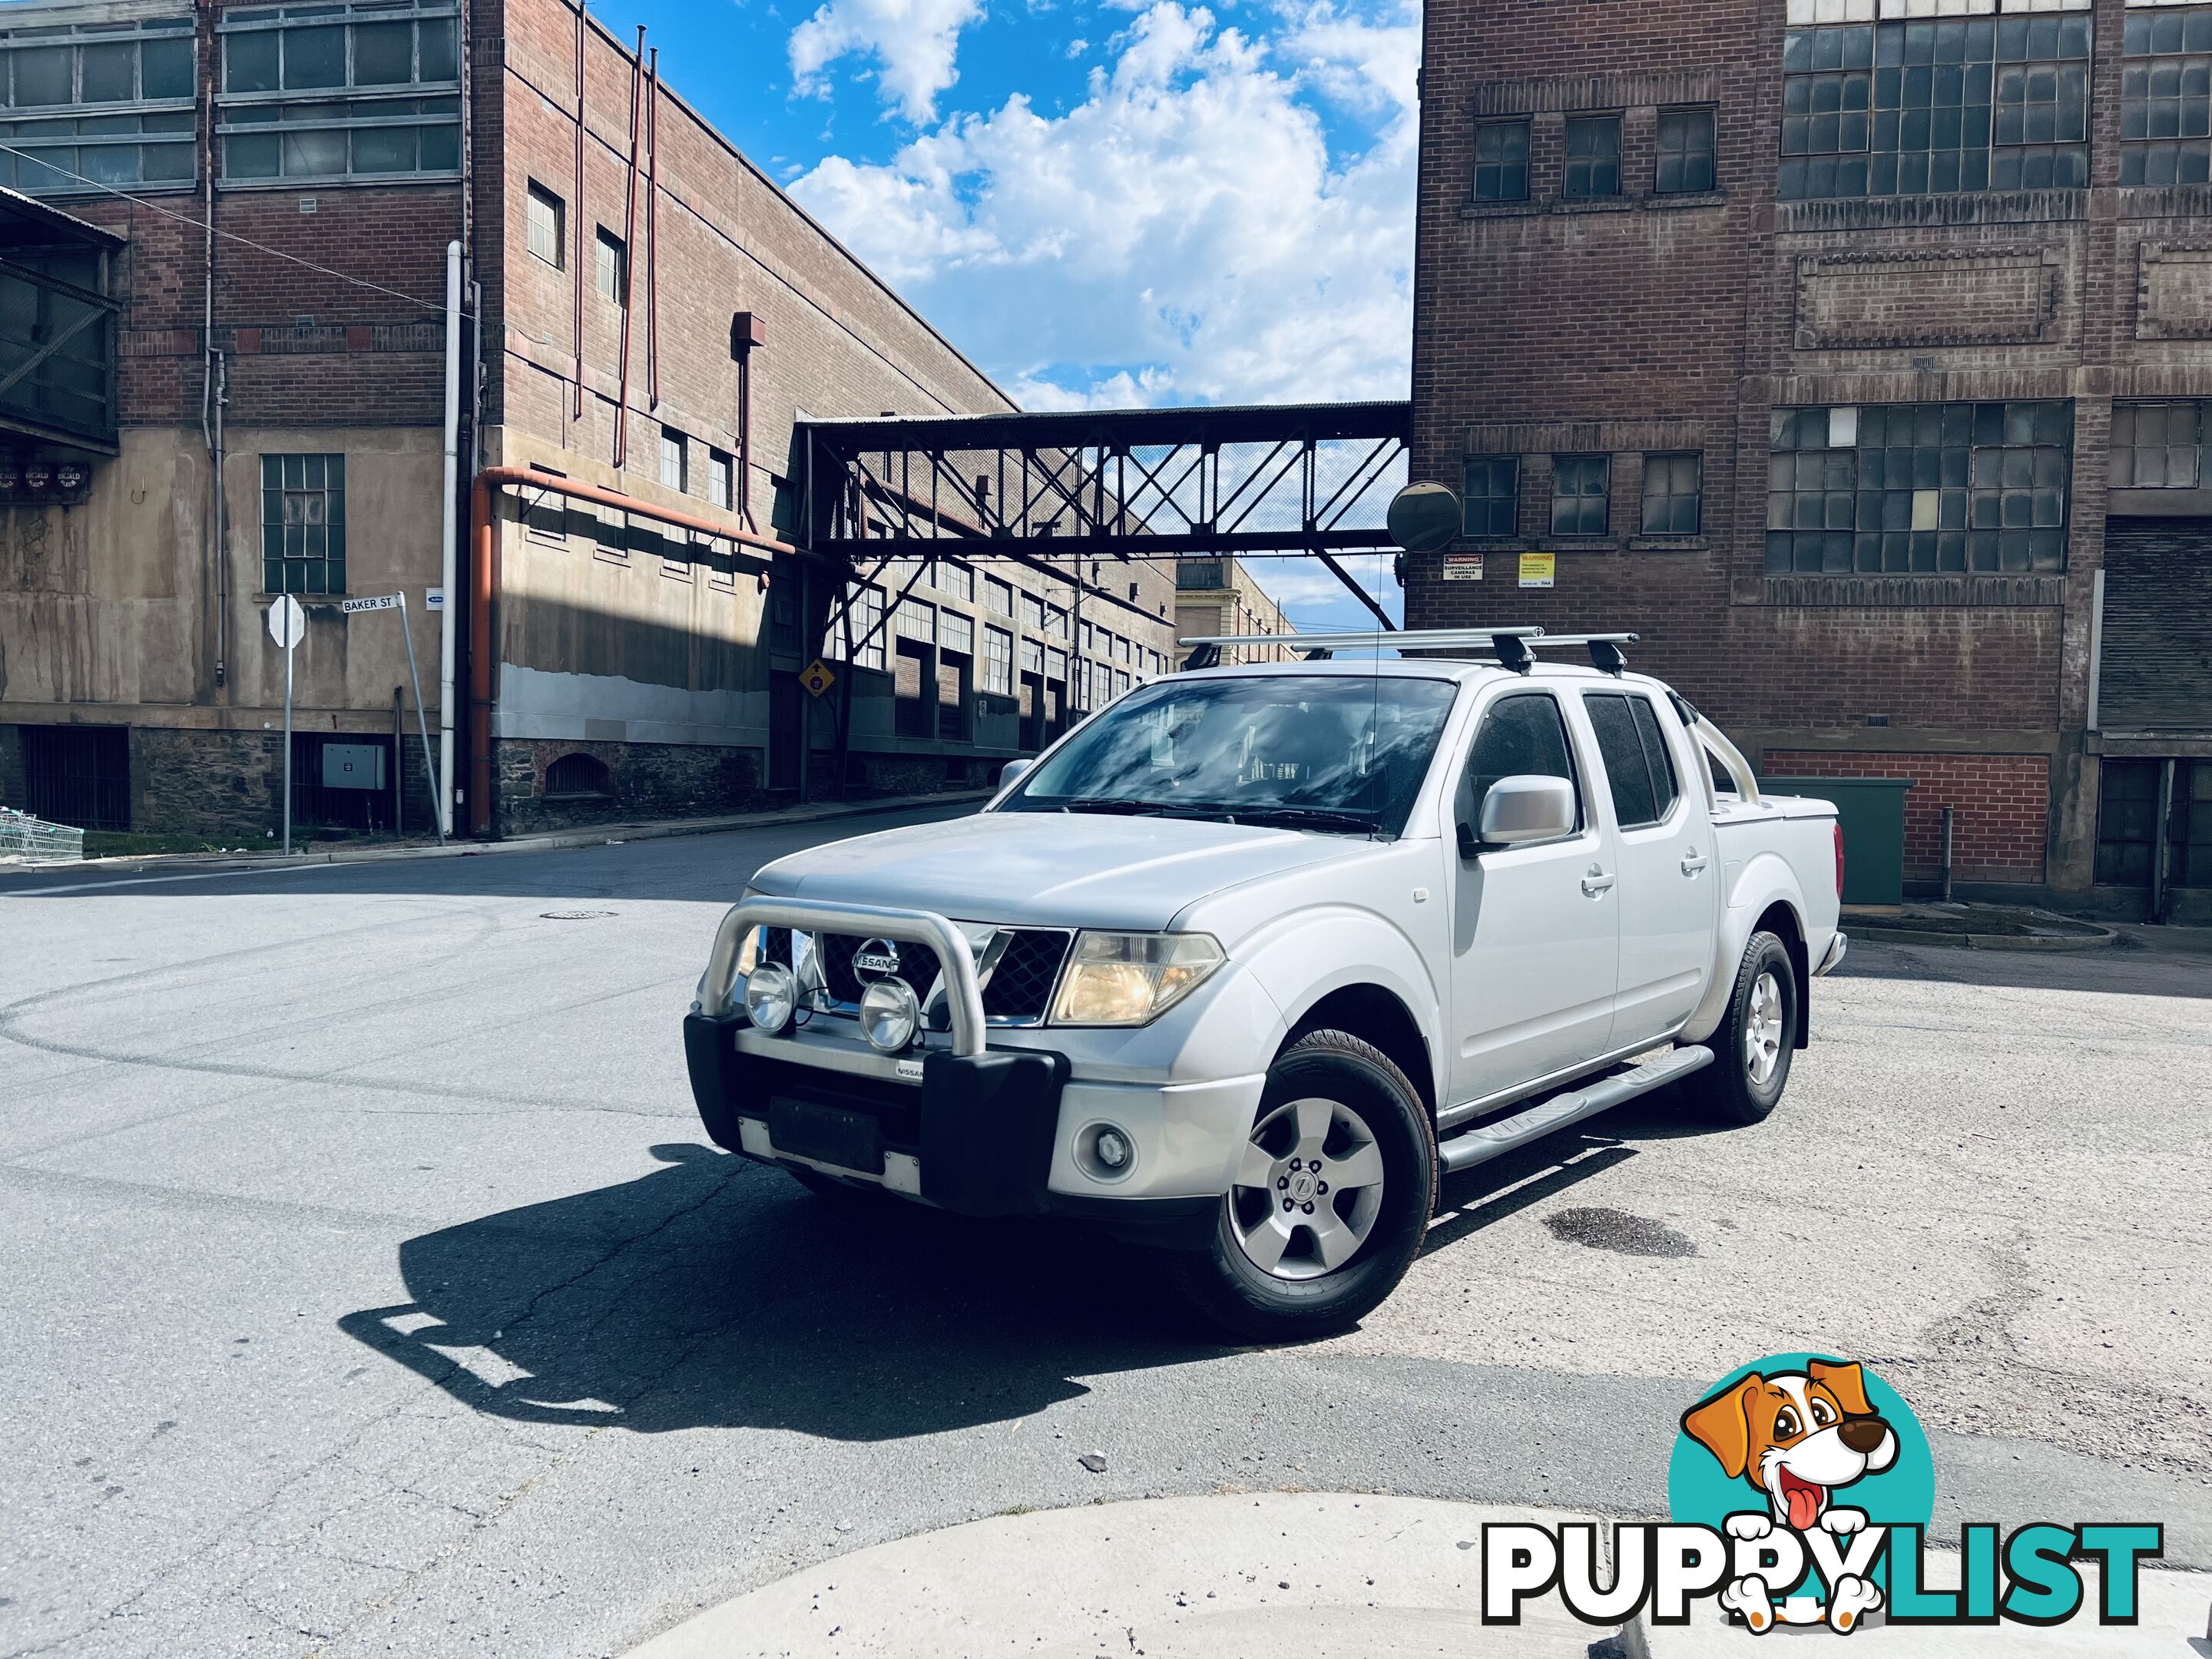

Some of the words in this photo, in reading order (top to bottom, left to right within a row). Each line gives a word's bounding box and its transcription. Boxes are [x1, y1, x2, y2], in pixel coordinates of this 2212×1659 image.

[344, 599, 377, 611] BAKER
[380, 598, 392, 608] ST
[853, 955, 891, 969] NISSAN
